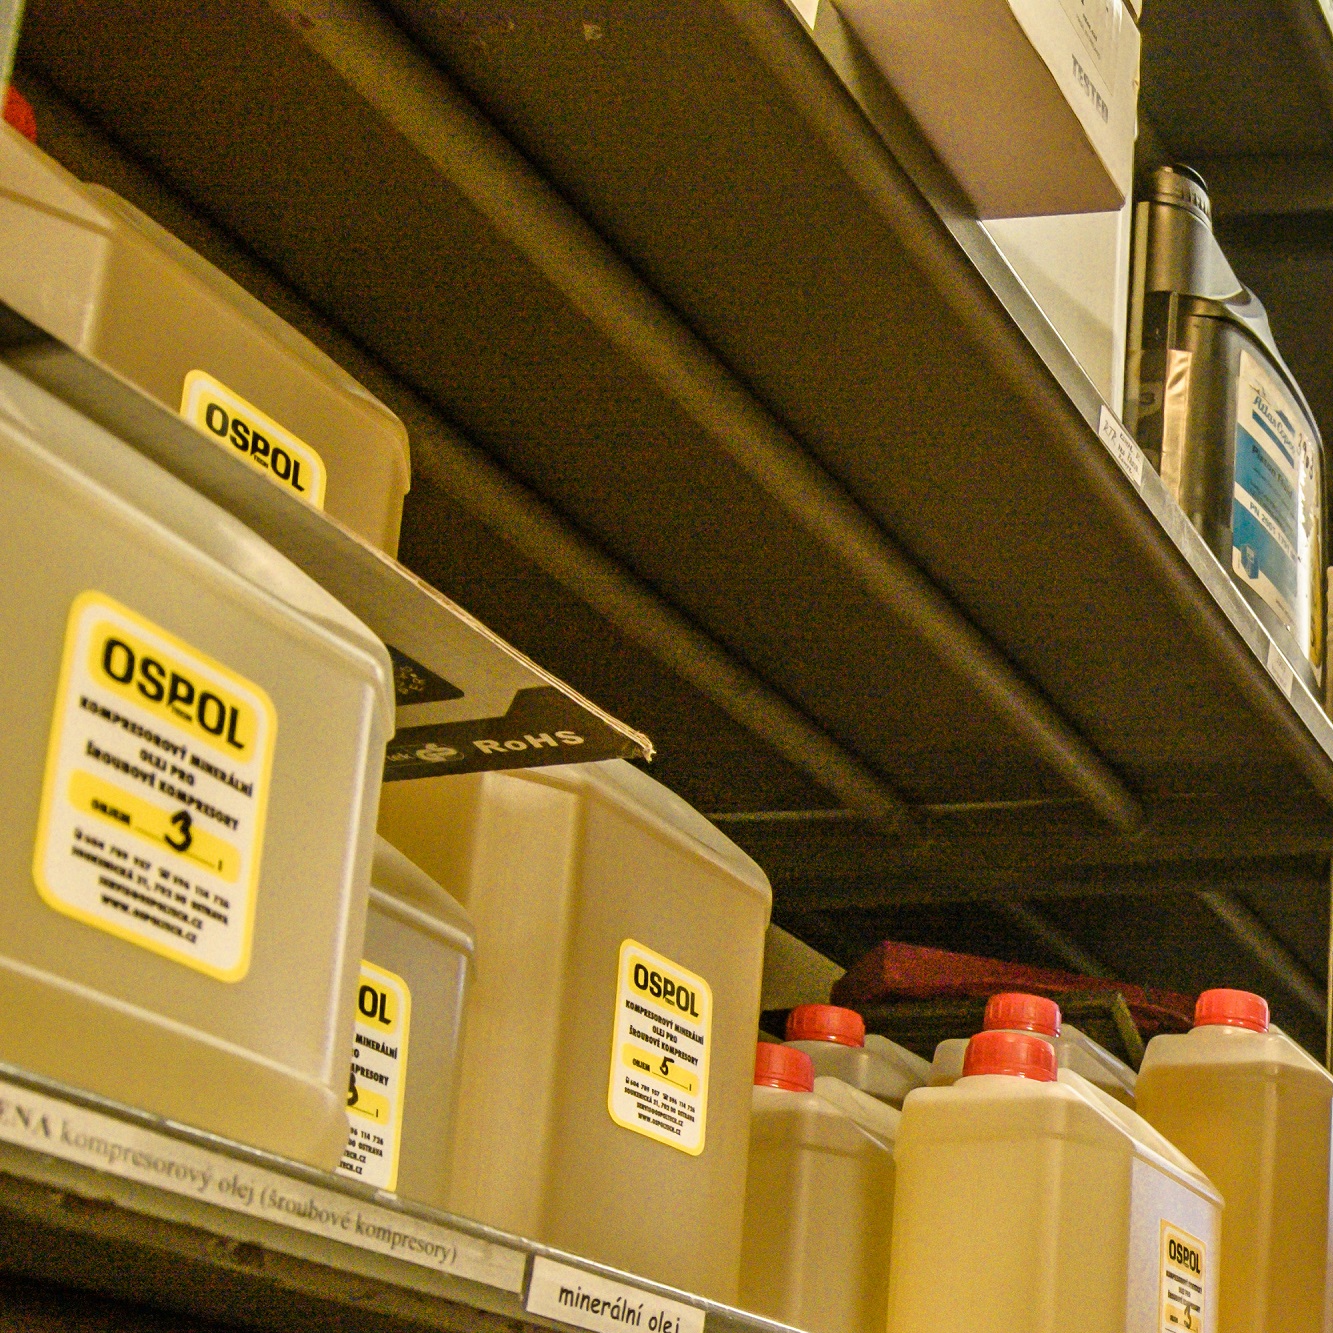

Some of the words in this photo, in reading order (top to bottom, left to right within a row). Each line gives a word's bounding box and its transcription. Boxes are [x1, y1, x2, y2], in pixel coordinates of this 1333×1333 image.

[205, 402, 305, 492] OSPOL
[101, 636, 246, 751] OSPOL
[472, 731, 585, 755] RoHS
[139, 748, 168, 772] OLEJ
[170, 764, 195, 787] PRO
[163, 809, 193, 853] 3
[633, 963, 699, 1018] OSPOL
[625, 999, 674, 1030] KOMPRESOROVÝ
[674, 1023, 704, 1046] MINERÁLNÍ
[652, 1025, 665, 1038] OLEJ
[666, 1031, 678, 1044] PRO
[355, 1033, 398, 1060] MINERÁLNÍ
[629, 1024, 661, 1049] ŠROUBOVÉ
[661, 1042, 699, 1066] KOMPRESORY
[659, 1055, 675, 1076] 5
[350, 1065, 390, 1087] PRESORY
[60, 1120, 214, 1193] kompresorový
[217, 1171, 256, 1207] olej
[259, 1182, 352, 1230] (šroubové
[353, 1209, 458, 1266] kompresory)
[1168, 1239, 1201, 1275] OSPOL
[558, 1285, 644, 1327] minerální
